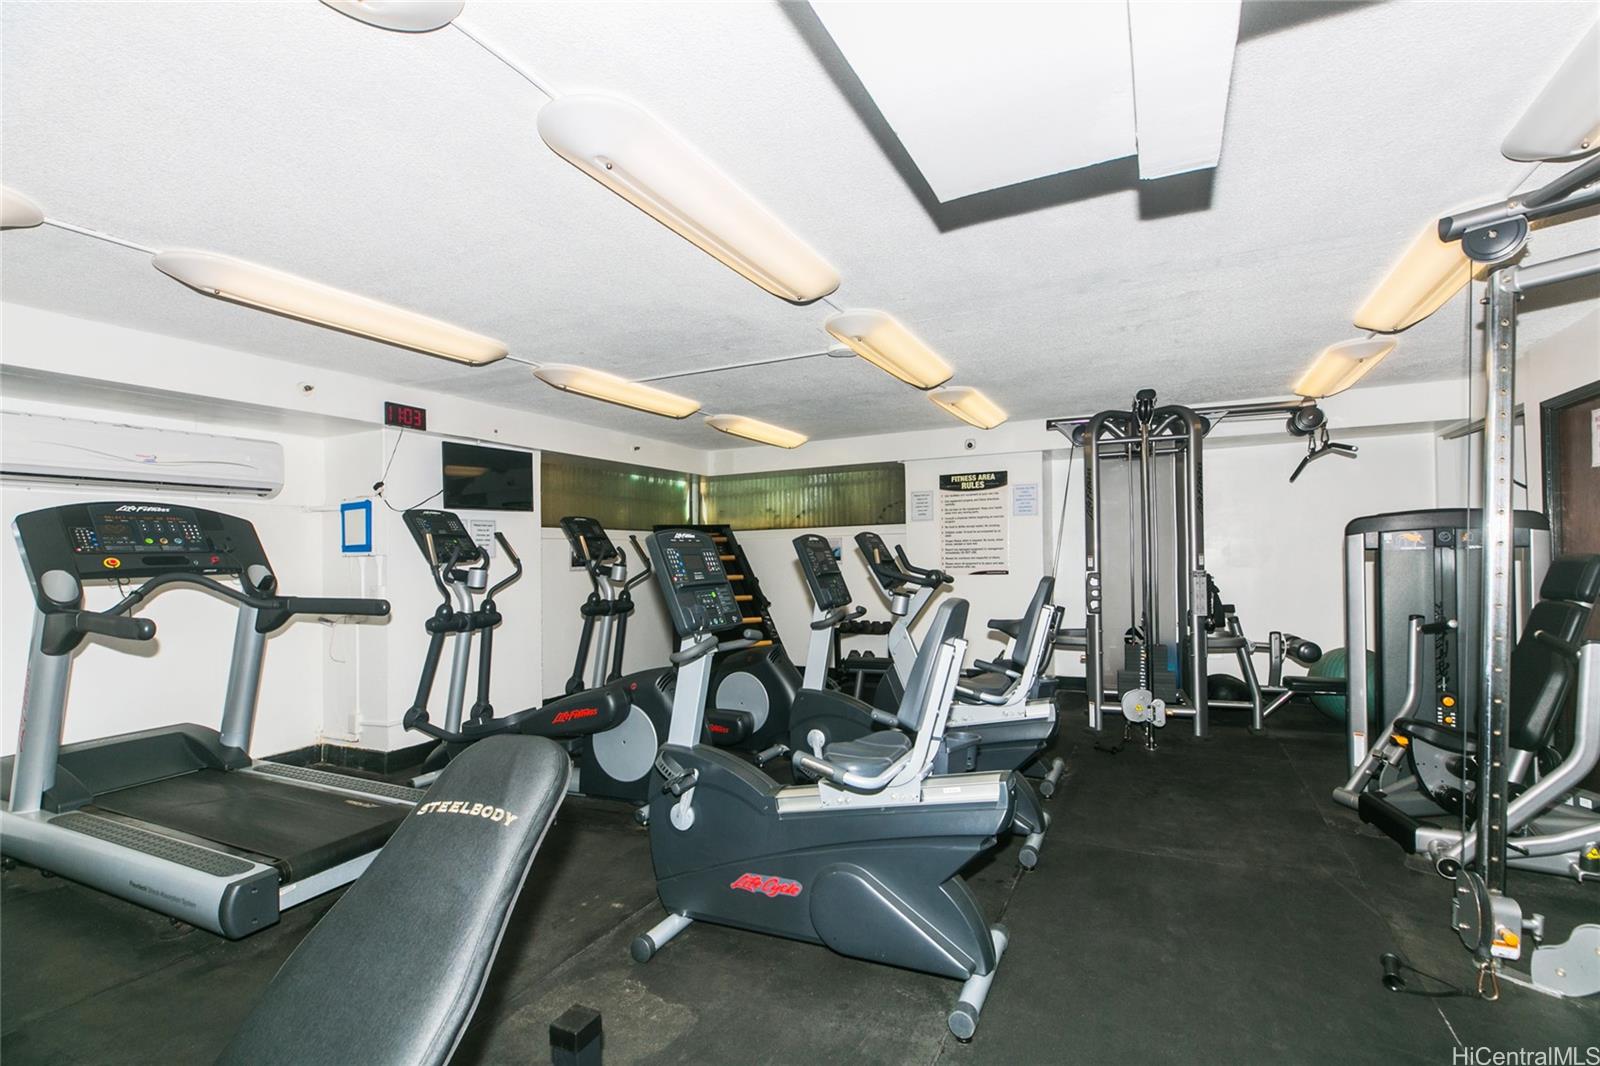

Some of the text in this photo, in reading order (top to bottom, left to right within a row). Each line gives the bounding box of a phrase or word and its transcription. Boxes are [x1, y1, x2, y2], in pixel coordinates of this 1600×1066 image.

[951, 473, 996, 483] FITNESS AREA
[961, 480, 985, 490] RULES
[416, 800, 519, 827] STEELBODY
